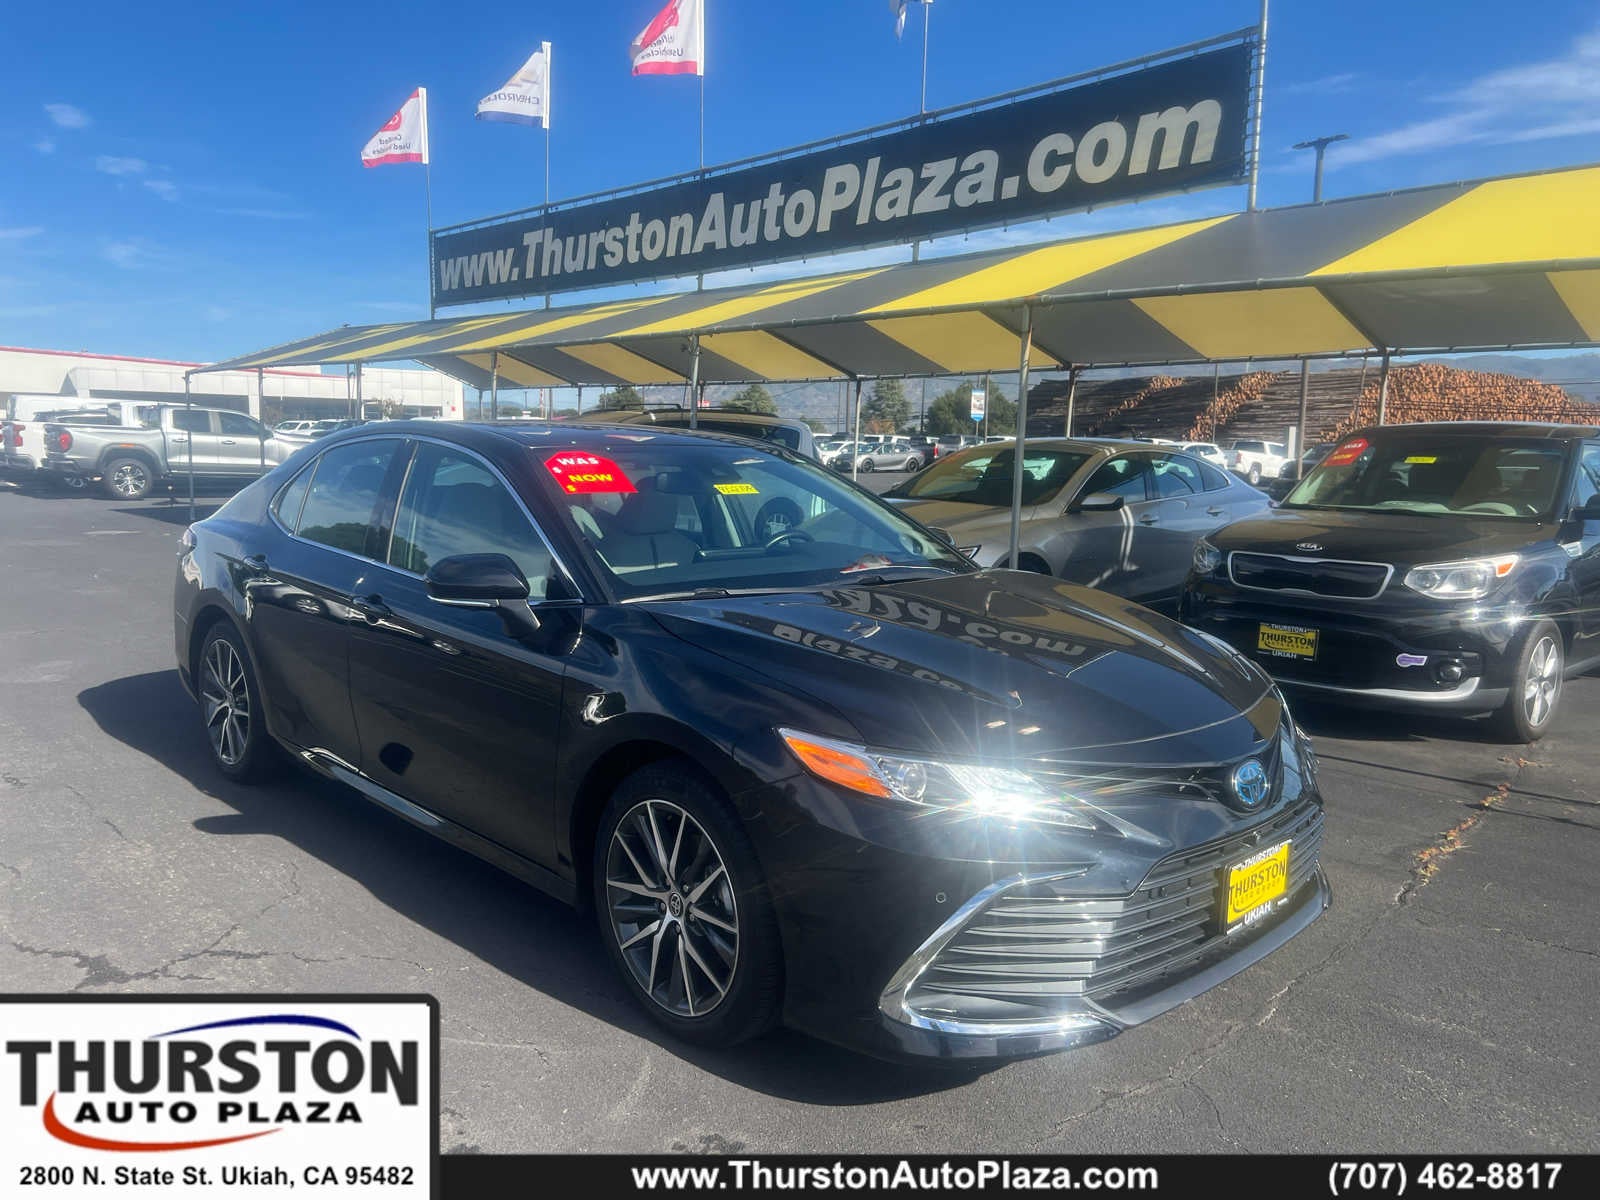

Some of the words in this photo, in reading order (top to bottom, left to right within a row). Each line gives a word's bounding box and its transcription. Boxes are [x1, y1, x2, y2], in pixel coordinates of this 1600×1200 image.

[440, 99, 1222, 291] www.ThurstonAutoPlaza.com
[556, 457, 599, 465] WAS
[568, 474, 613, 482] NOW
[1261, 632, 1313, 648] THURSTON
[1229, 859, 1286, 906] THURSTON
[1244, 900, 1271, 924] UKIAH
